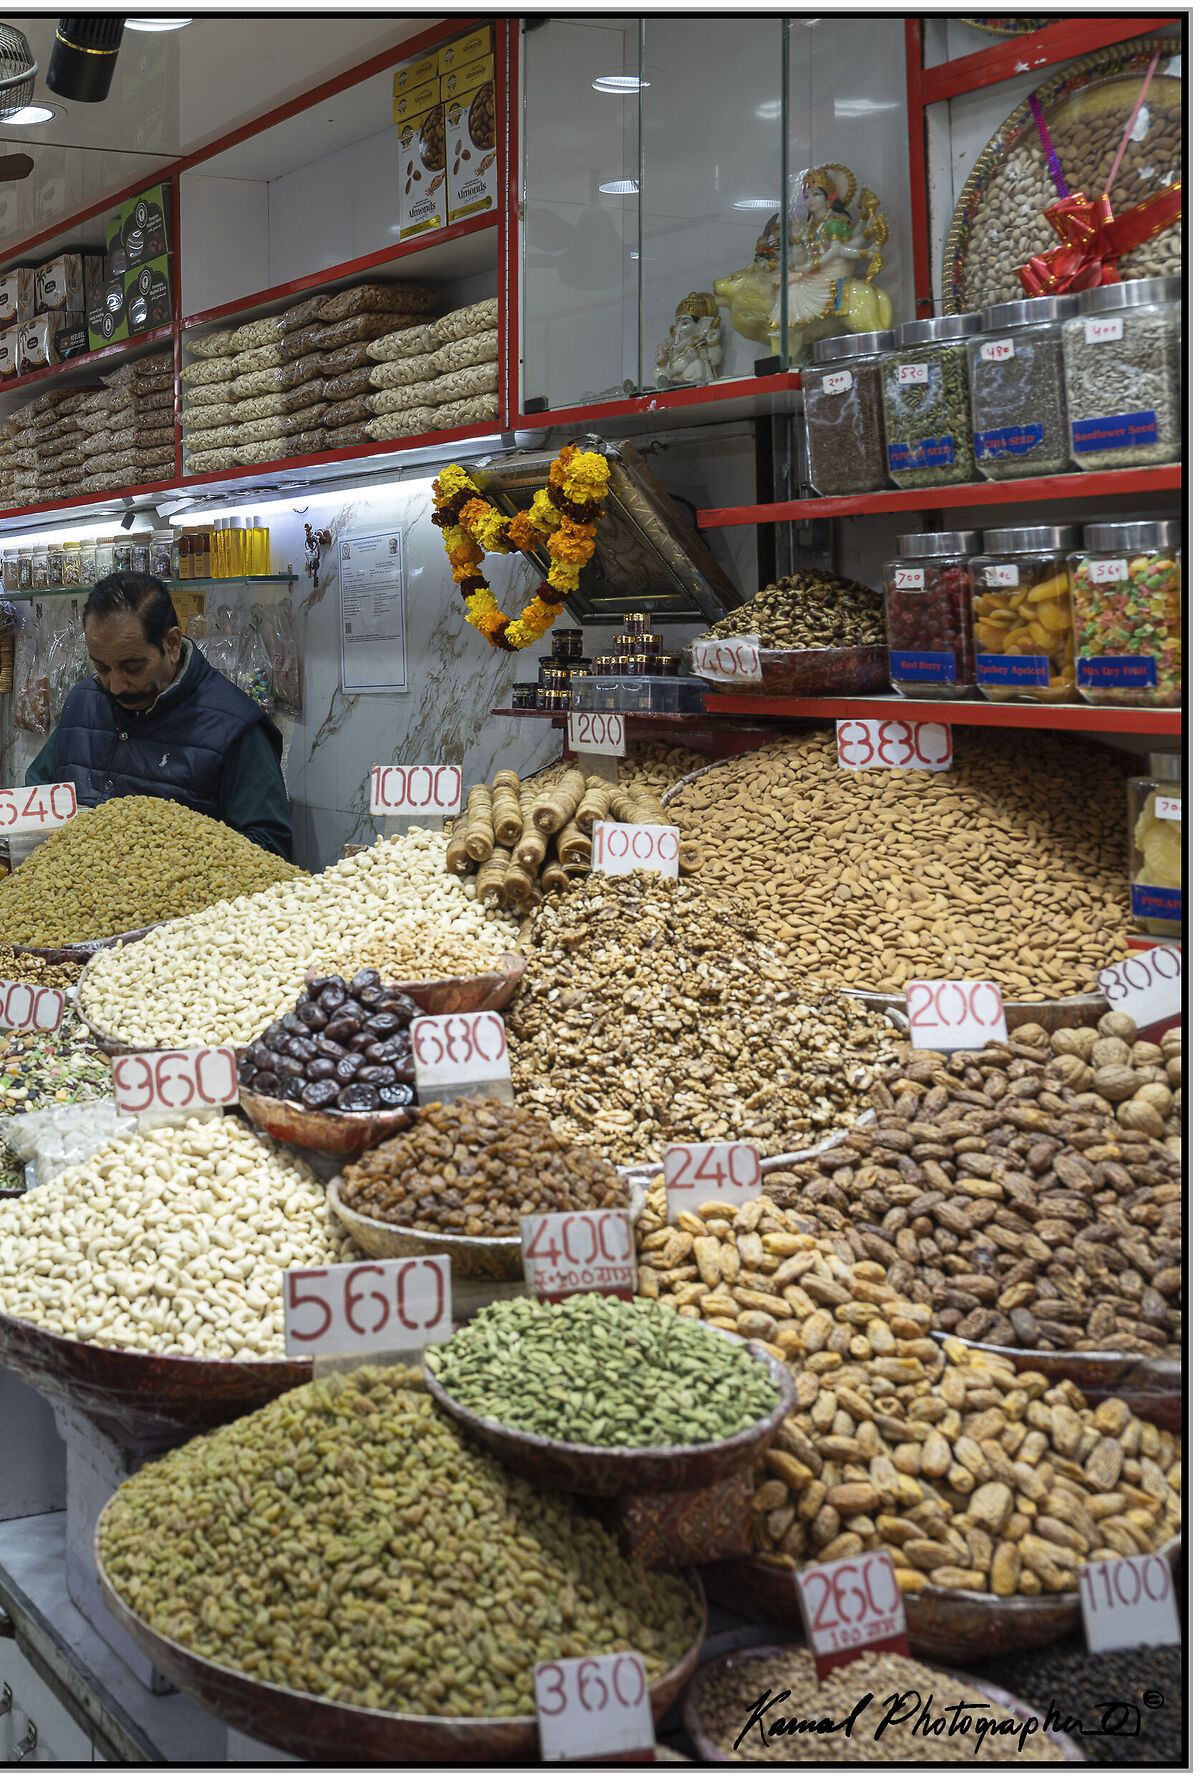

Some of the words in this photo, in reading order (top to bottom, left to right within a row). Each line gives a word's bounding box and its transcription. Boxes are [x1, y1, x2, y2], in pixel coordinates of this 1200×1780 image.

[408, 201, 437, 219] Almonds
[457, 181, 487, 200] Almonds
[927, 445, 952, 457] SEED
[983, 437, 1007, 449] CHIA
[1008, 434, 1036, 446] SEED
[1073, 430, 1126, 442] Sunflower
[1128, 422, 1156, 435] Seed
[897, 572, 921, 586] 700
[693, 644, 758, 675] 1400
[901, 660, 917, 669] Red
[918, 661, 941, 673] Berry
[978, 664, 1009, 677] Turkey
[1010, 664, 1047, 676] Apricot
[1082, 666, 1100, 676] Mix
[1101, 666, 1120, 678] Dry
[1122, 666, 1148, 676] Fruit
[567, 712, 622, 744] 1200
[837, 720, 953, 766] 880
[373, 766, 462, 807] 1000
[595, 826, 679, 864] 1000
[1097, 947, 1180, 1001] 800
[905, 983, 1004, 1027] 200
[413, 1016, 506, 1065] 680
[114, 1048, 238, 1112] 960
[666, 1144, 761, 1190] 240
[525, 1212, 633, 1267] 400
[288, 1259, 444, 1341] 560
[803, 1556, 900, 1633] 260
[1080, 1559, 1170, 1613] 1100
[536, 1652, 645, 1716] 360
